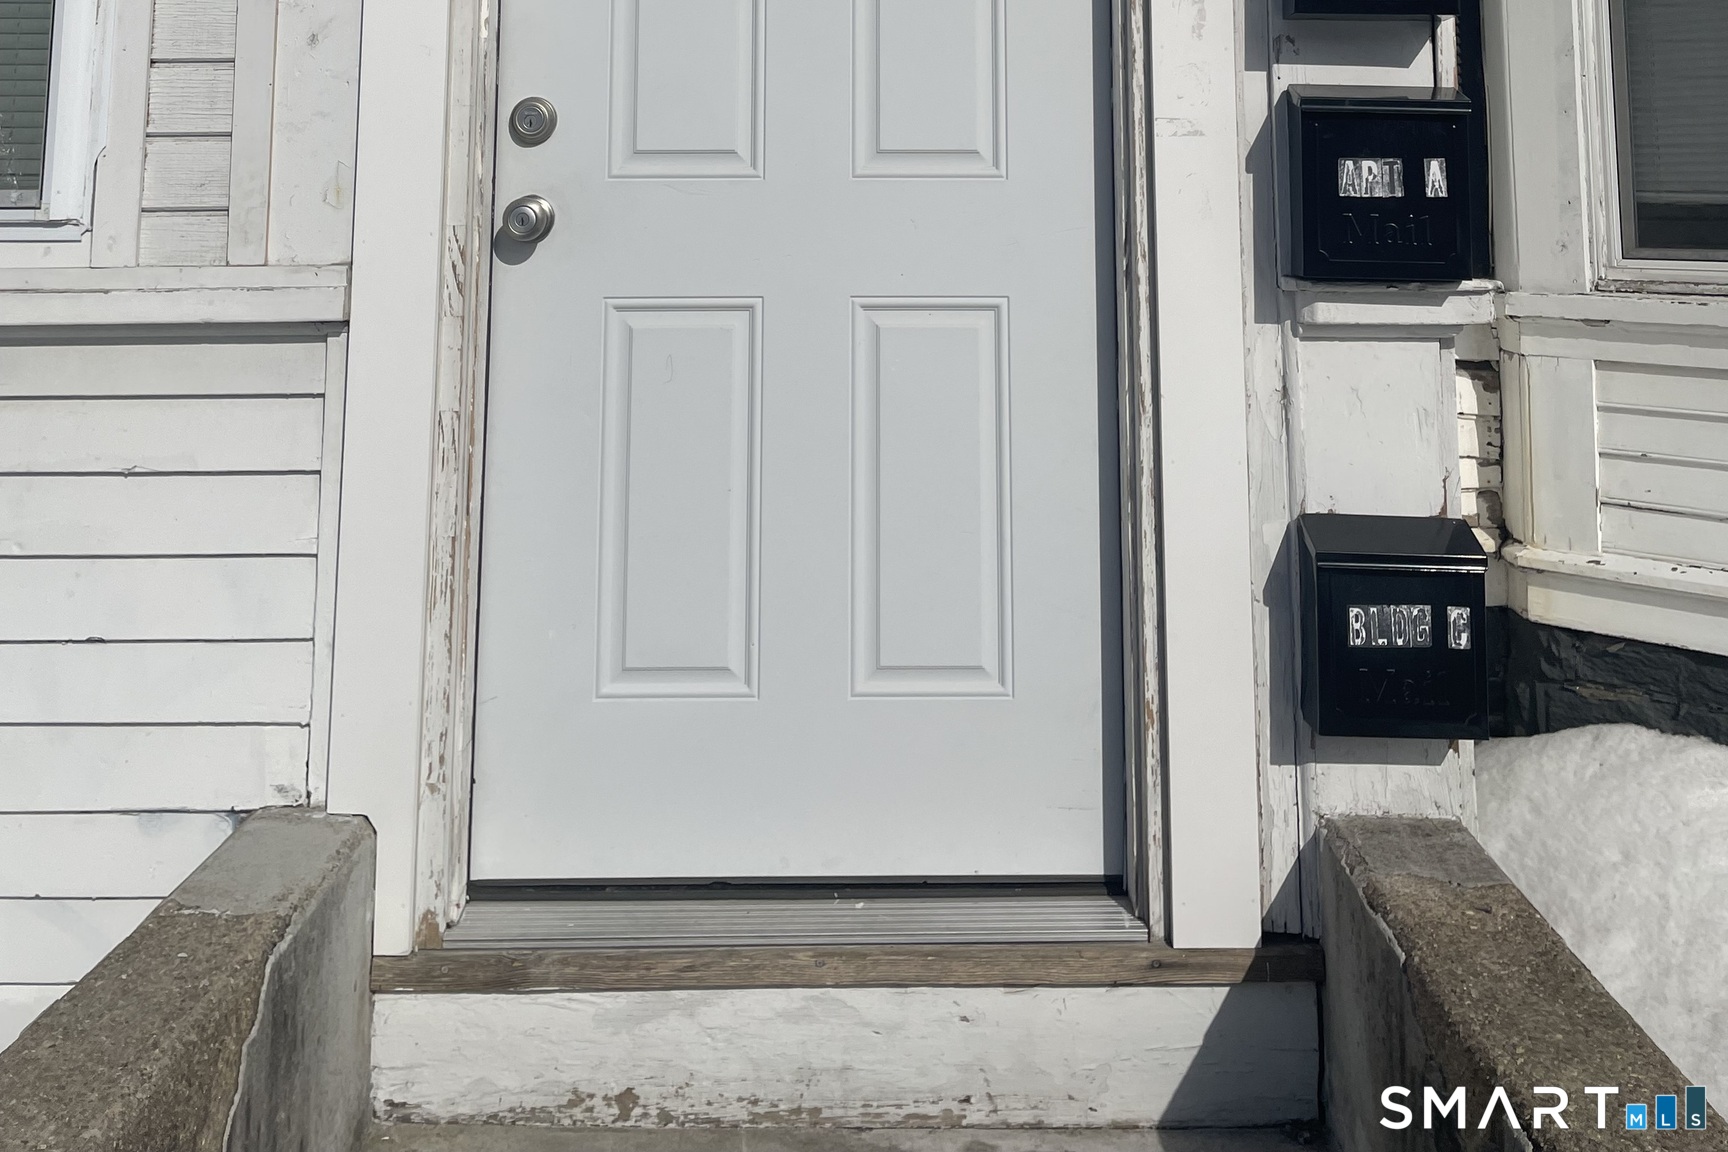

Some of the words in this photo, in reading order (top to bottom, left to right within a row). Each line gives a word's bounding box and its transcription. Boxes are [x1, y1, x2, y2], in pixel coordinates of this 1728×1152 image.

[1339, 159, 1402, 196] APT
[1426, 159, 1446, 196] A
[1342, 212, 1433, 245] Mail
[1348, 605, 1431, 646] BLDG
